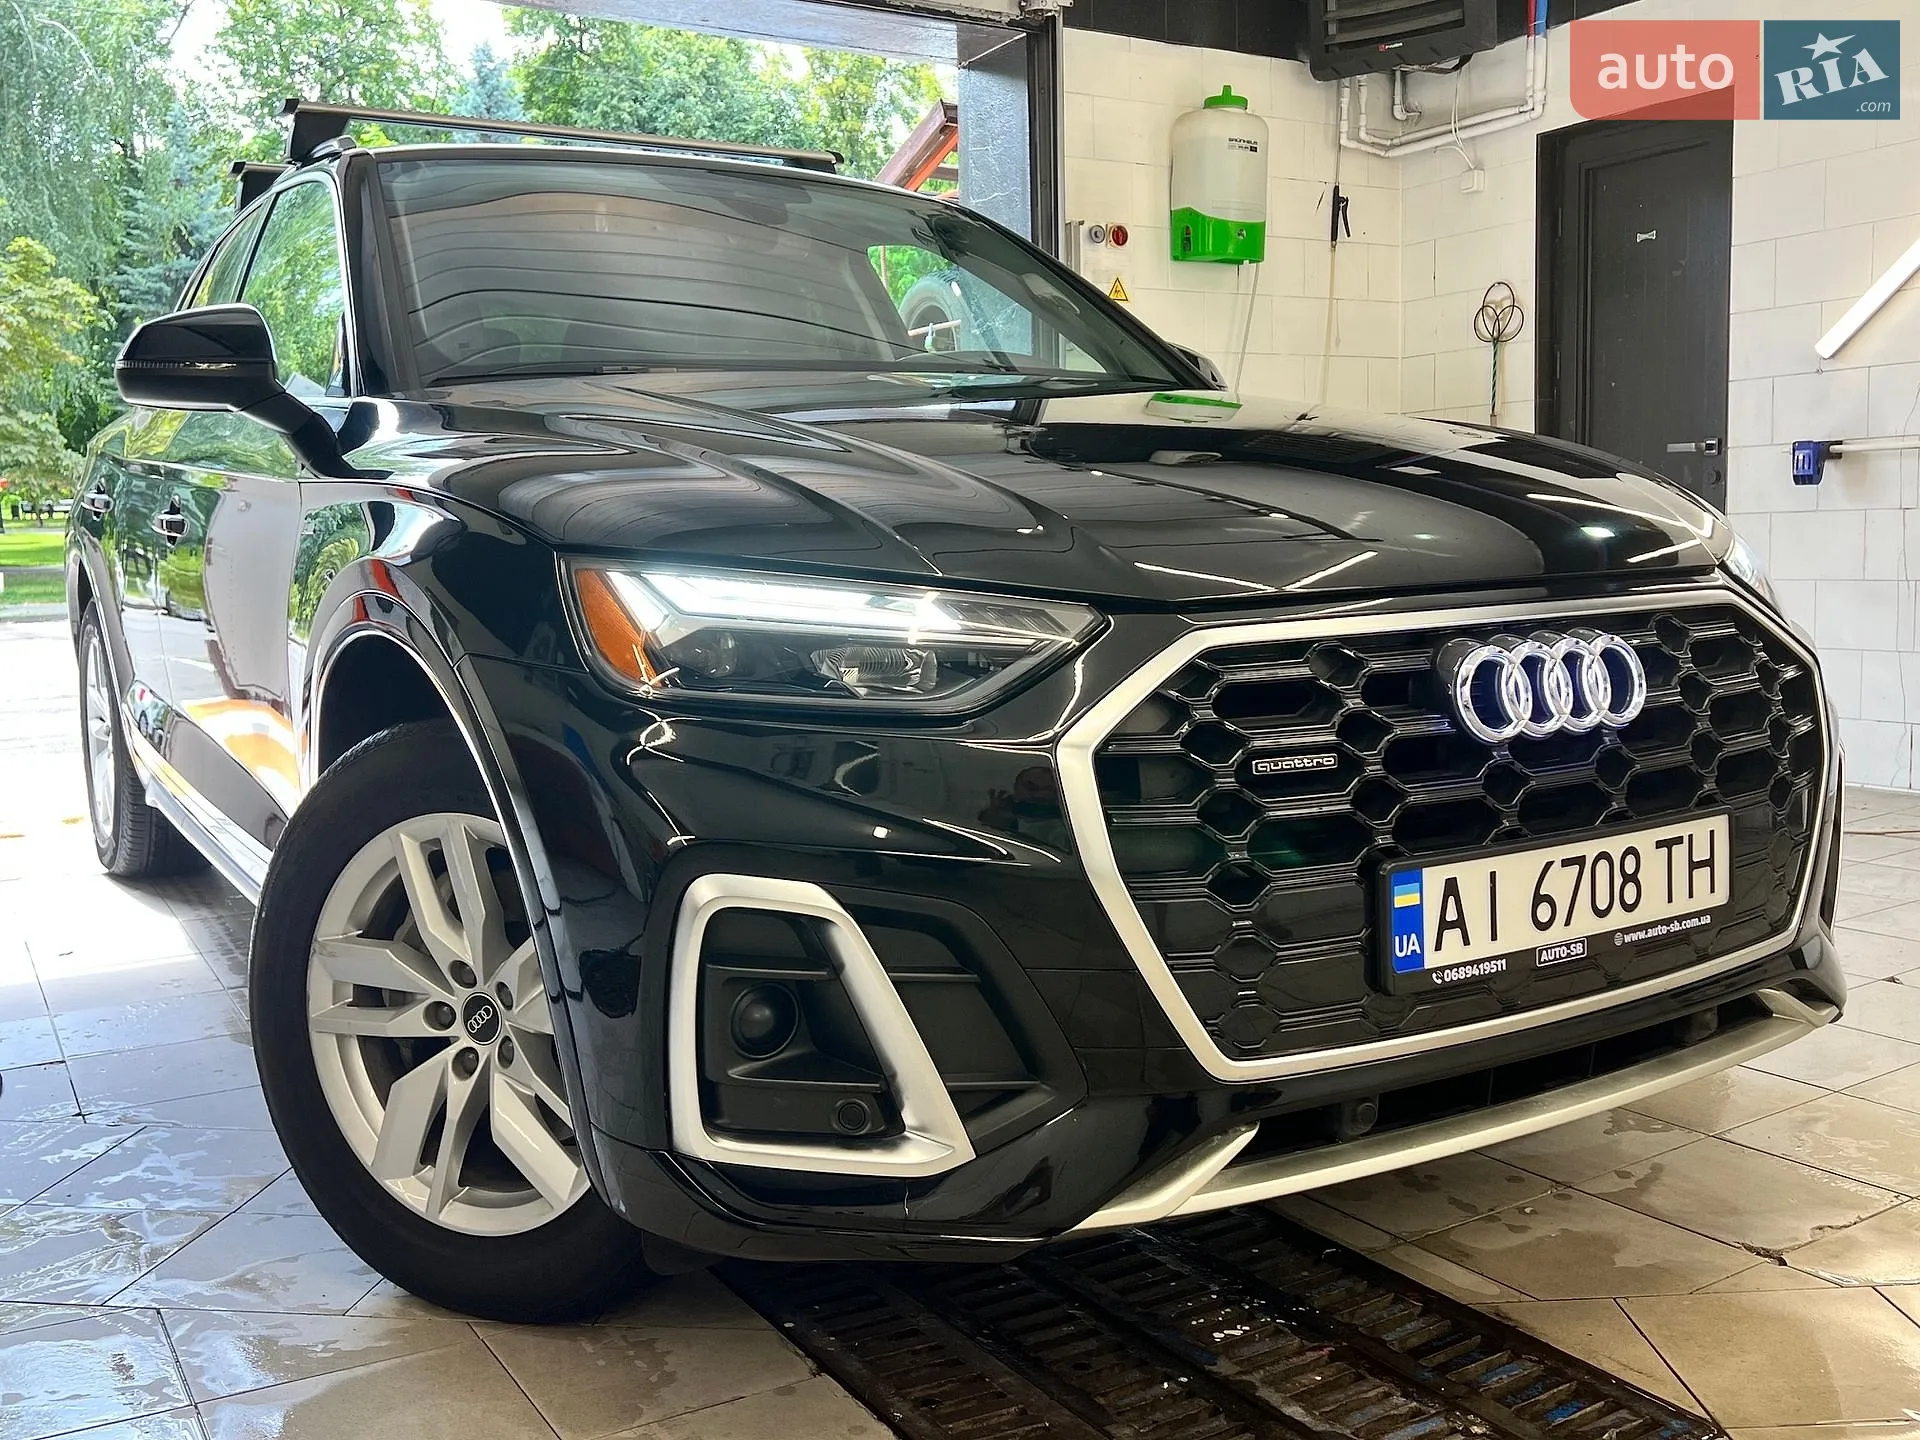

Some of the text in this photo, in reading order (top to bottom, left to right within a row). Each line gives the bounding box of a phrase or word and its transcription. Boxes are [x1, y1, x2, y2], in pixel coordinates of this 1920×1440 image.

[1257, 756, 1335, 772] quattro
[1434, 828, 1716, 953] AI 6708 TH
[1623, 914, 1712, 943] www.auto-sb.com.ua
[1394, 932, 1421, 958] UA
[1540, 942, 1584, 963] AUTO-SB
[1443, 958, 1507, 983] 0689419511
